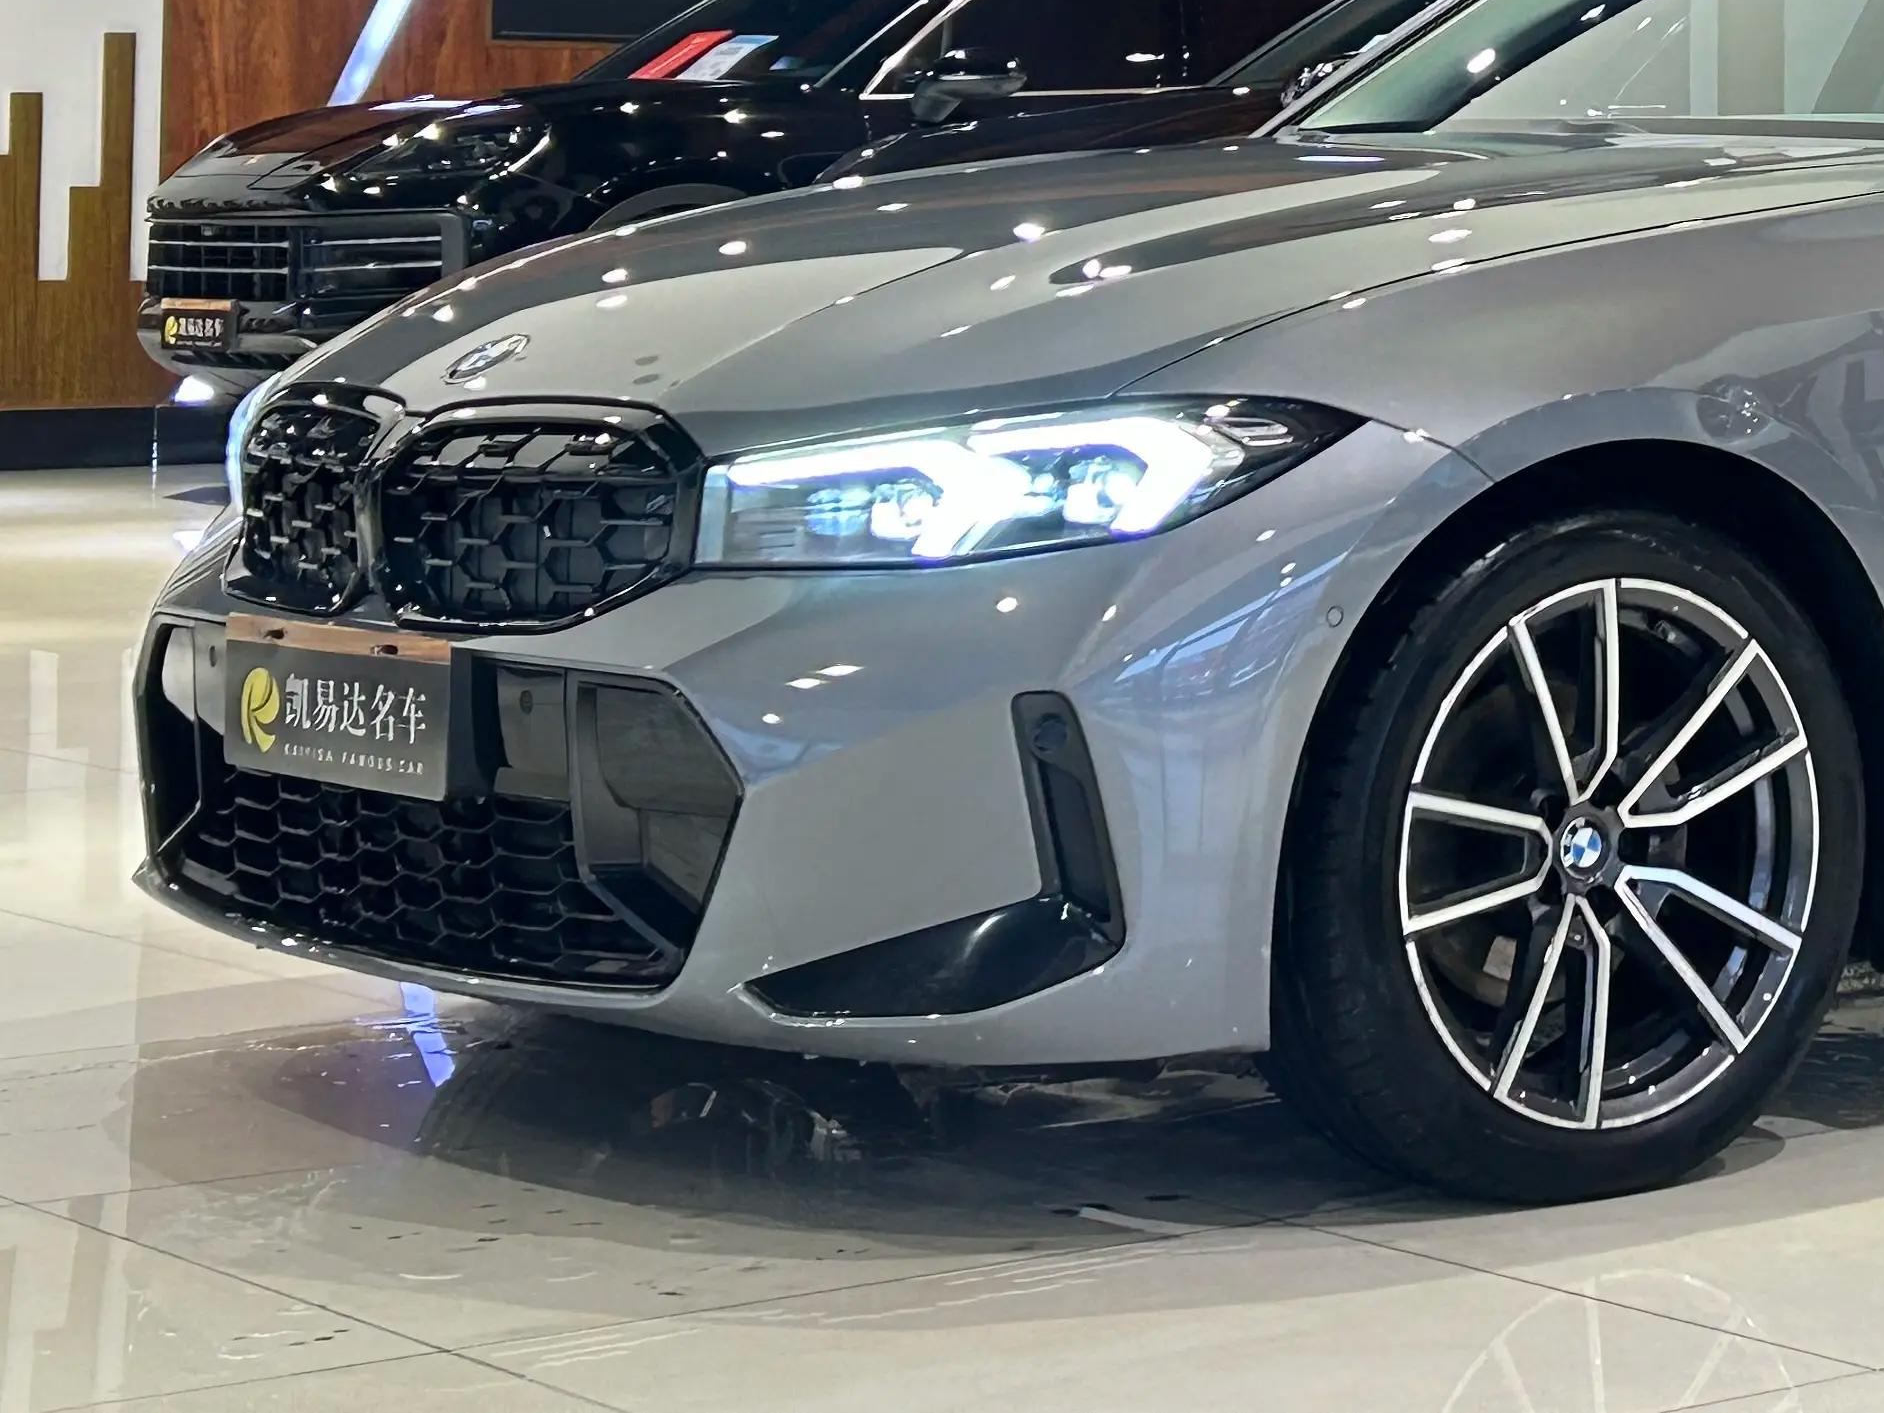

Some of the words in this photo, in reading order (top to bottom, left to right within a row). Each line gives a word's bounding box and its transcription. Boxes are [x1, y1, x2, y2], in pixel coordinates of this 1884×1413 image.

[284, 672, 427, 745] 凯易达名车
[341, 751, 393, 772] FAMOUS
[398, 759, 424, 775] CAR
